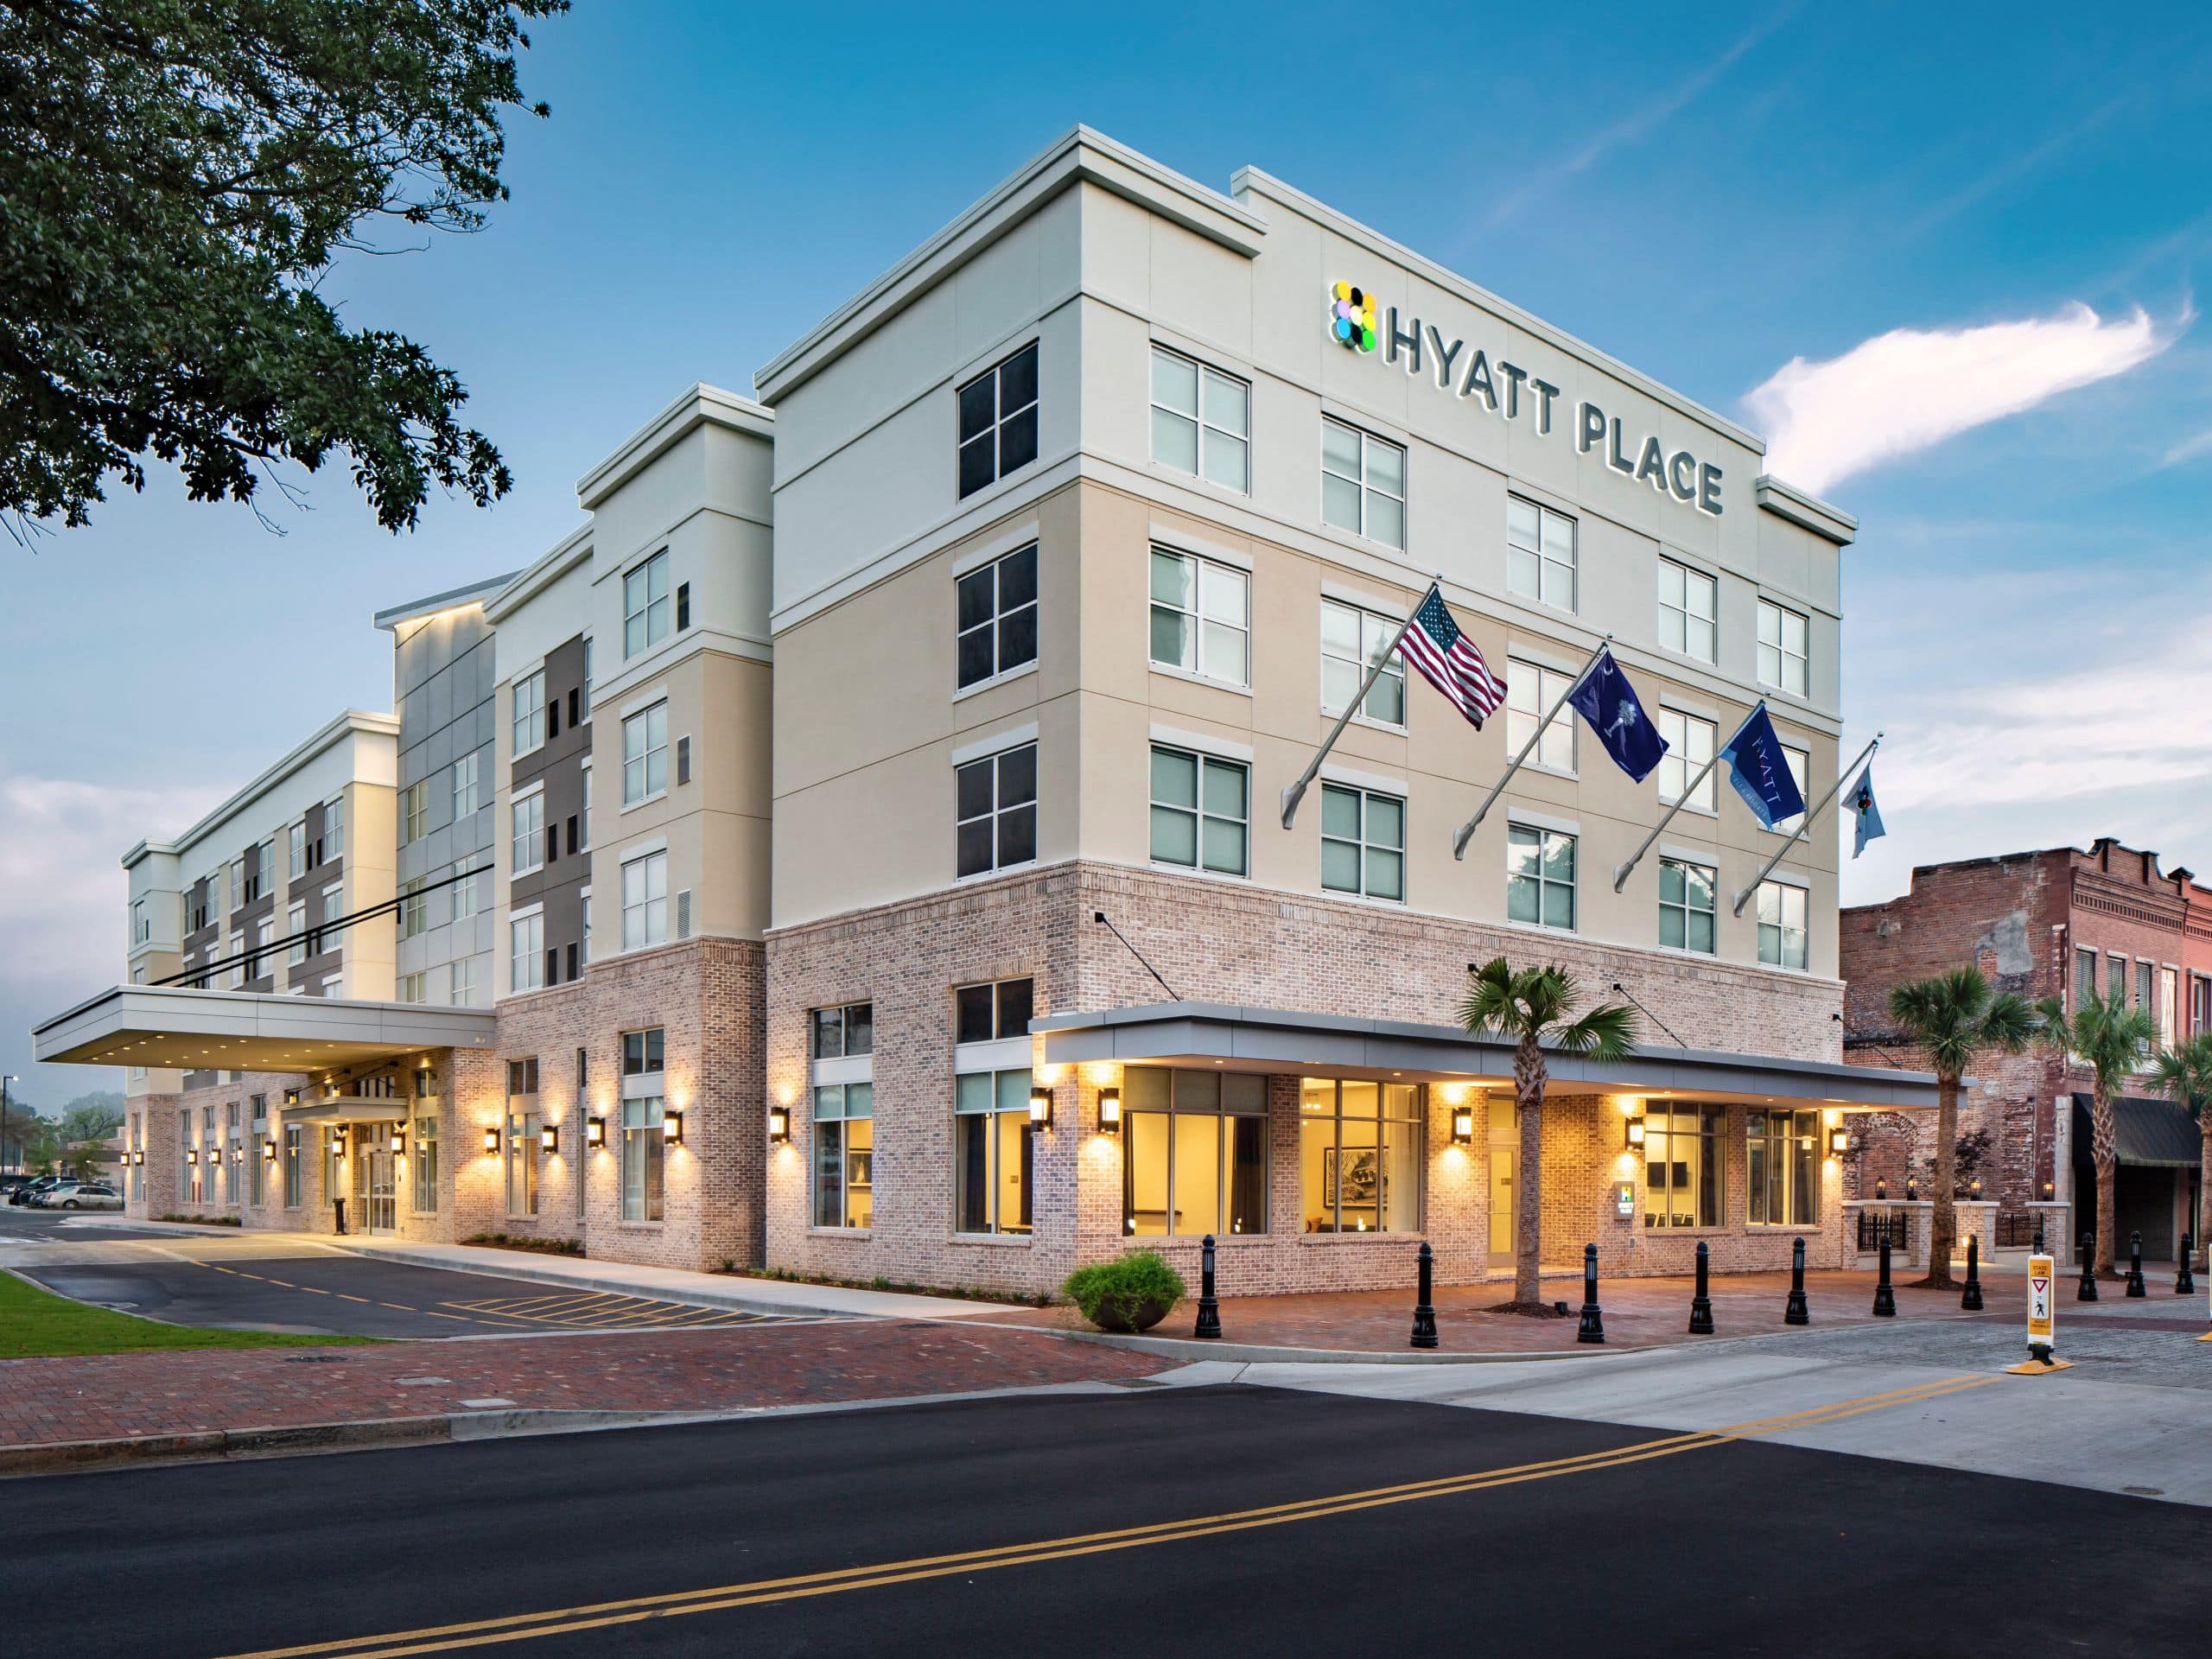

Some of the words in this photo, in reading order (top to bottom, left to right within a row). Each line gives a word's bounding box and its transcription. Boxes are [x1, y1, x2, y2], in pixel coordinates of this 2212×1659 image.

[1385, 307, 1560, 435] HYATT
[1578, 402, 1723, 515] PLACE
[1751, 735, 1781, 803] HYATT
